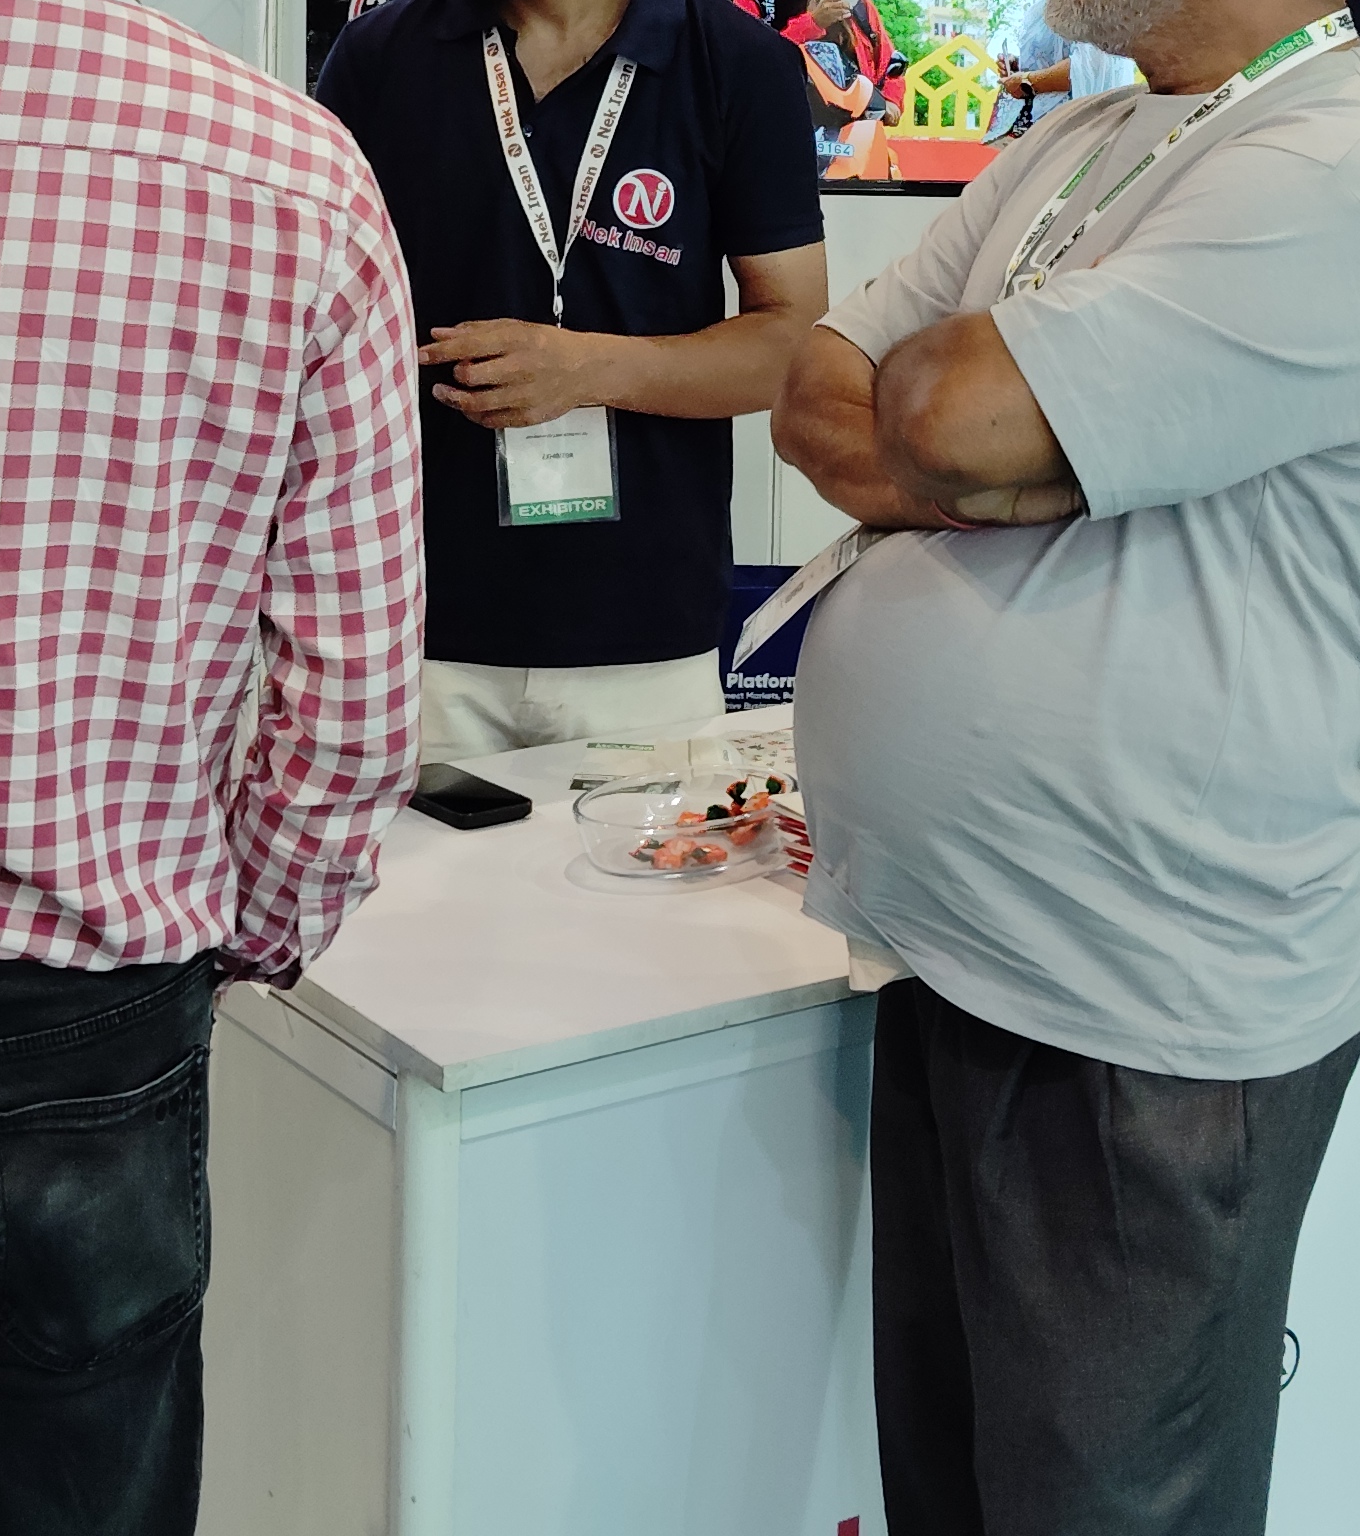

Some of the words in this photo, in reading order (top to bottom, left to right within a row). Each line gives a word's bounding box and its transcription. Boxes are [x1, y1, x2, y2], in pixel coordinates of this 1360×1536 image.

[493, 63, 510, 106] Insan
[597, 108, 619, 139] Nek
[609, 63, 634, 106] Insan
[502, 107, 516, 139] Nek
[518, 164, 540, 209] Insan
[576, 167, 598, 211] Insan
[534, 211, 550, 243] Nek
[580, 218, 623, 249] Nek
[623, 230, 682, 266] Insan
[519, 498, 607, 517] EXHIBITOR
